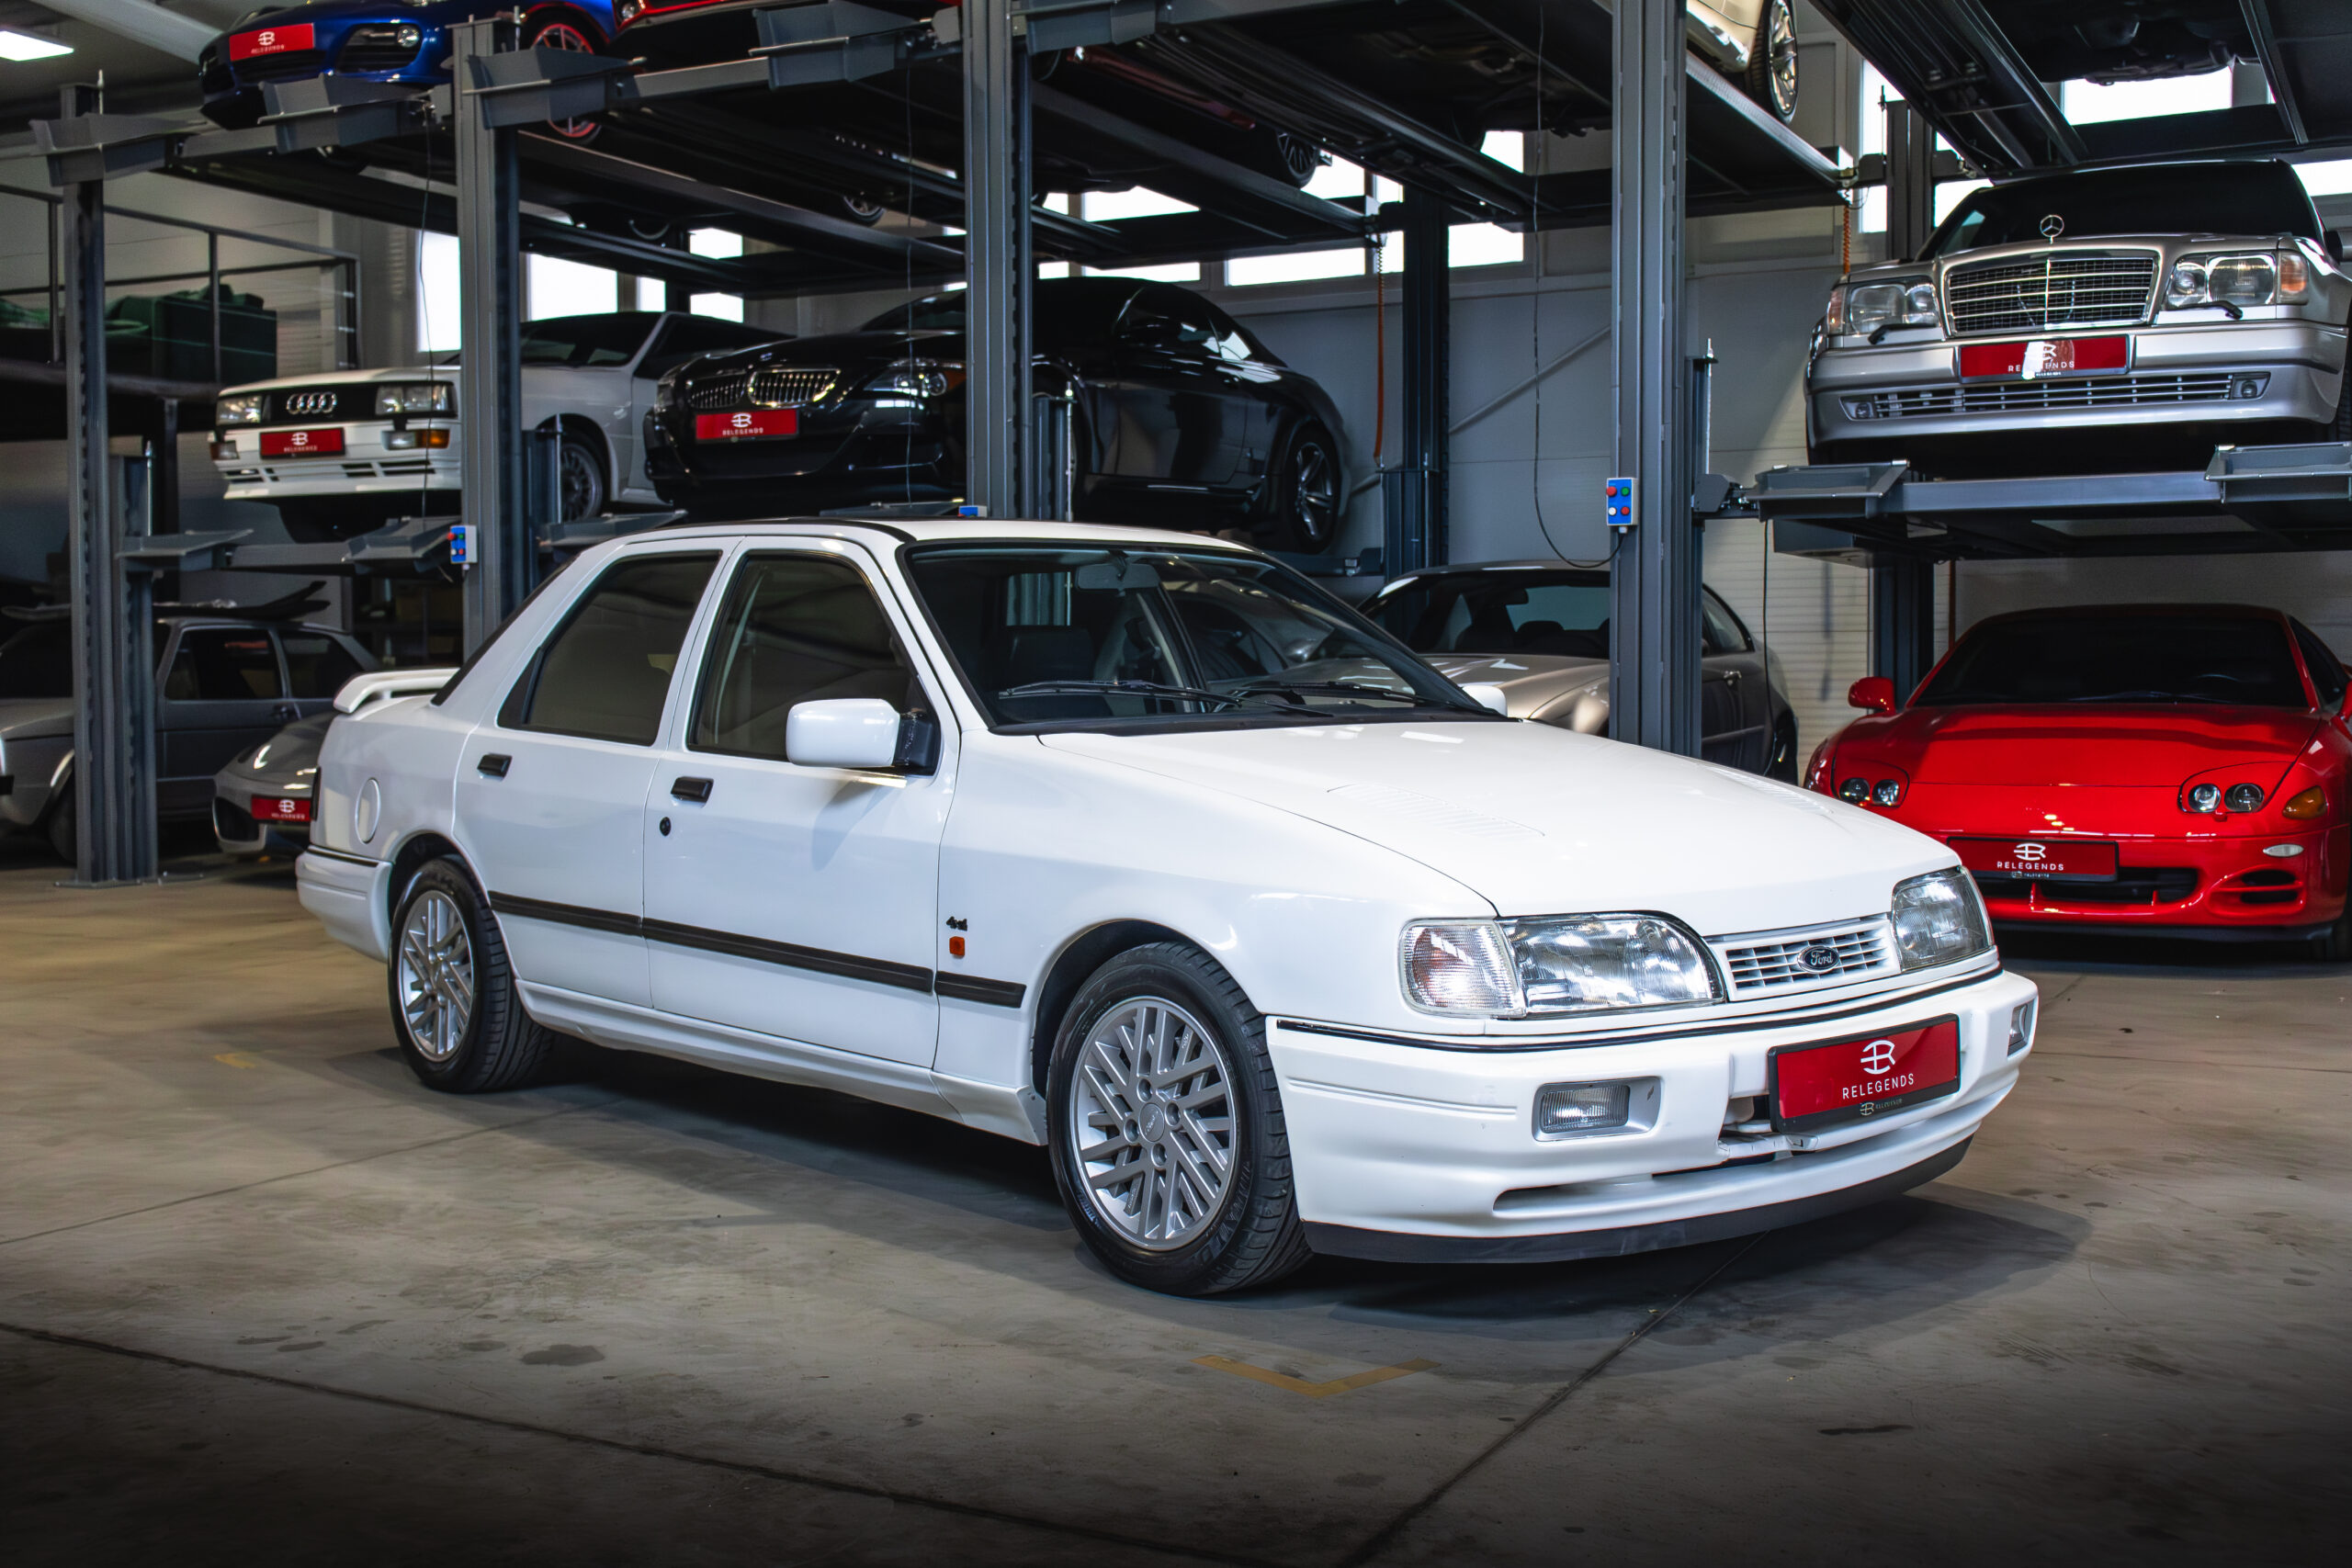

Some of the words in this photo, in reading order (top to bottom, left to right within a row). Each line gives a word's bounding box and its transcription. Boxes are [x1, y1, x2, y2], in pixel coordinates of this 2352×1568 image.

[2007, 360, 2075, 372] REENDS
[1996, 861, 2064, 871] RELEGENDS
[1811, 950, 1833, 965] Ford
[1842, 1073, 1914, 1100] RELEGENDS
